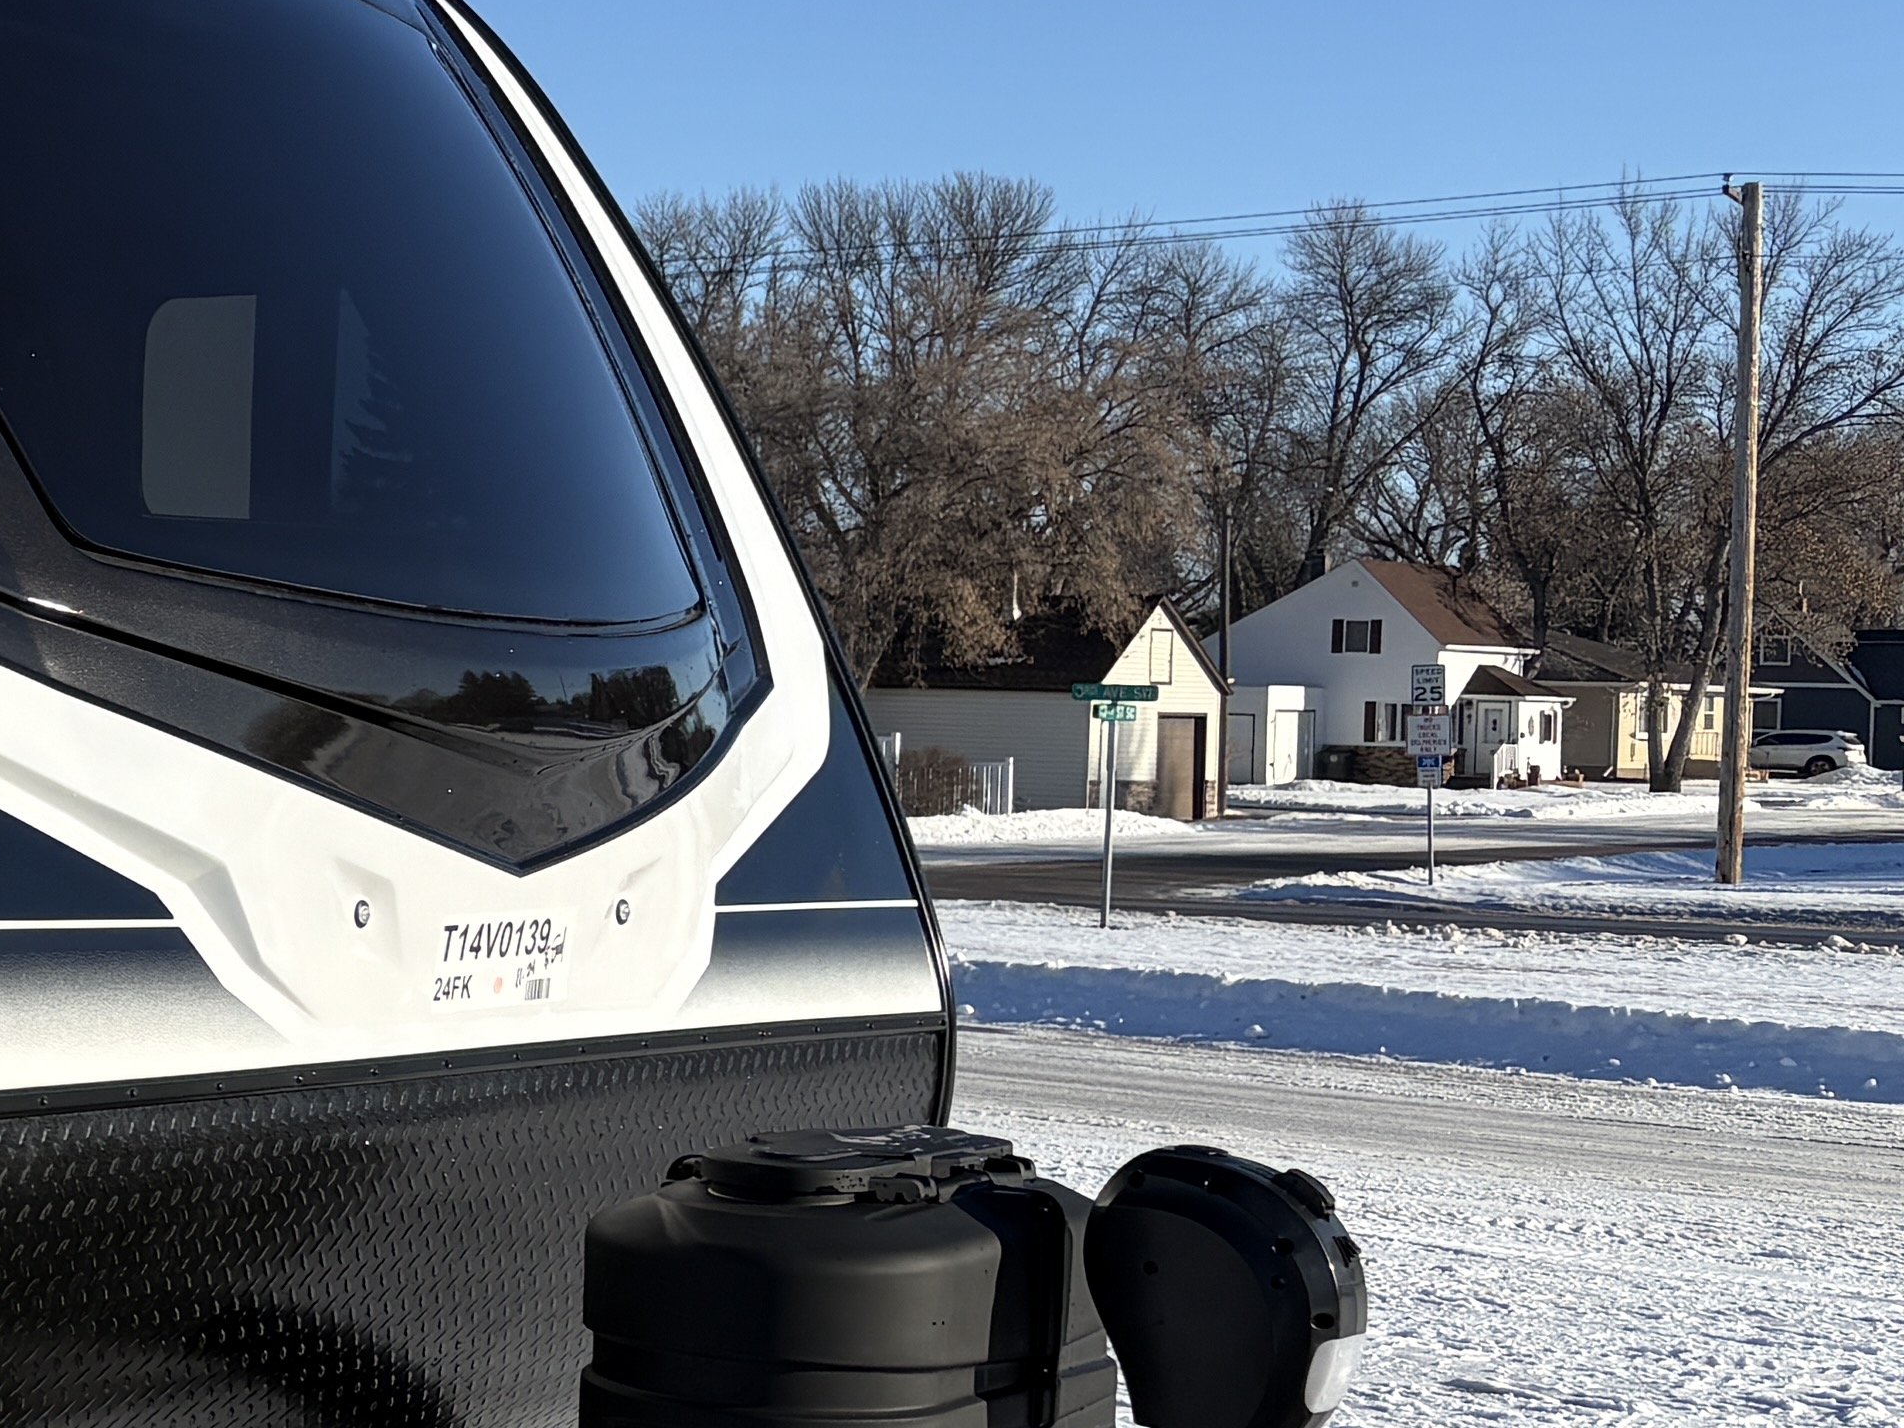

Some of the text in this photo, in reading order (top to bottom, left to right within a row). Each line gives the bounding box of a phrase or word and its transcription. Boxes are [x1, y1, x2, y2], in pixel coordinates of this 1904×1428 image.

[1414, 686, 1442, 702] 25
[443, 918, 552, 962] T14V0139
[433, 974, 473, 1001] 24FK
